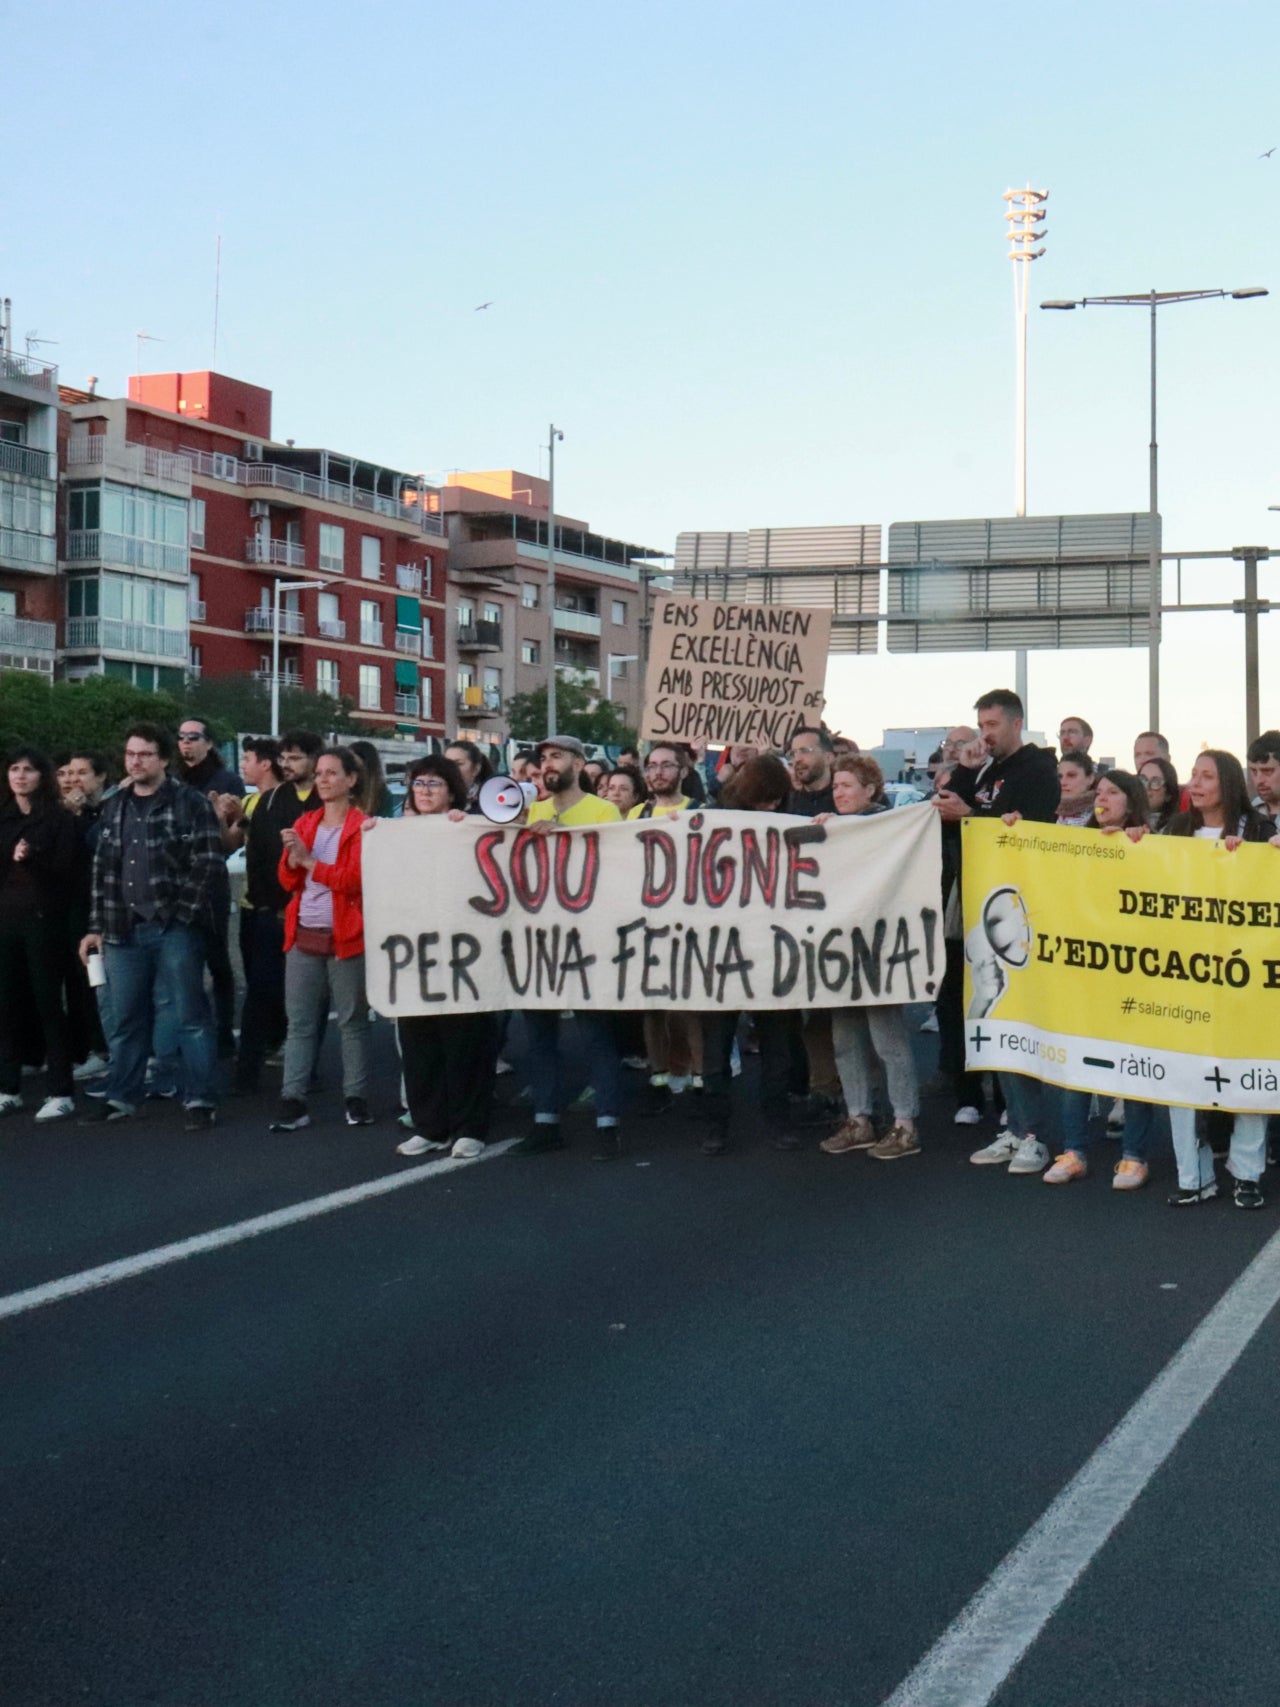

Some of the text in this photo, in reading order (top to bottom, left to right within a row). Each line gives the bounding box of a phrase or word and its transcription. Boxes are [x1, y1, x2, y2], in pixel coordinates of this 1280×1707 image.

[662, 603, 812, 637] ENS DEMANEN
[658, 666, 823, 708] AMB PRESSUPOST DE
[468, 829, 600, 917] SOU
[381, 930, 482, 1005] PER
[500, 925, 596, 1001] UNA
[1037, 932, 1251, 989] L'EDUCACIÓ
[1120, 997, 1212, 1025] #salaridigne
[999, 1032, 1067, 1065] recursos
[1120, 1053, 1166, 1081] ràtio
